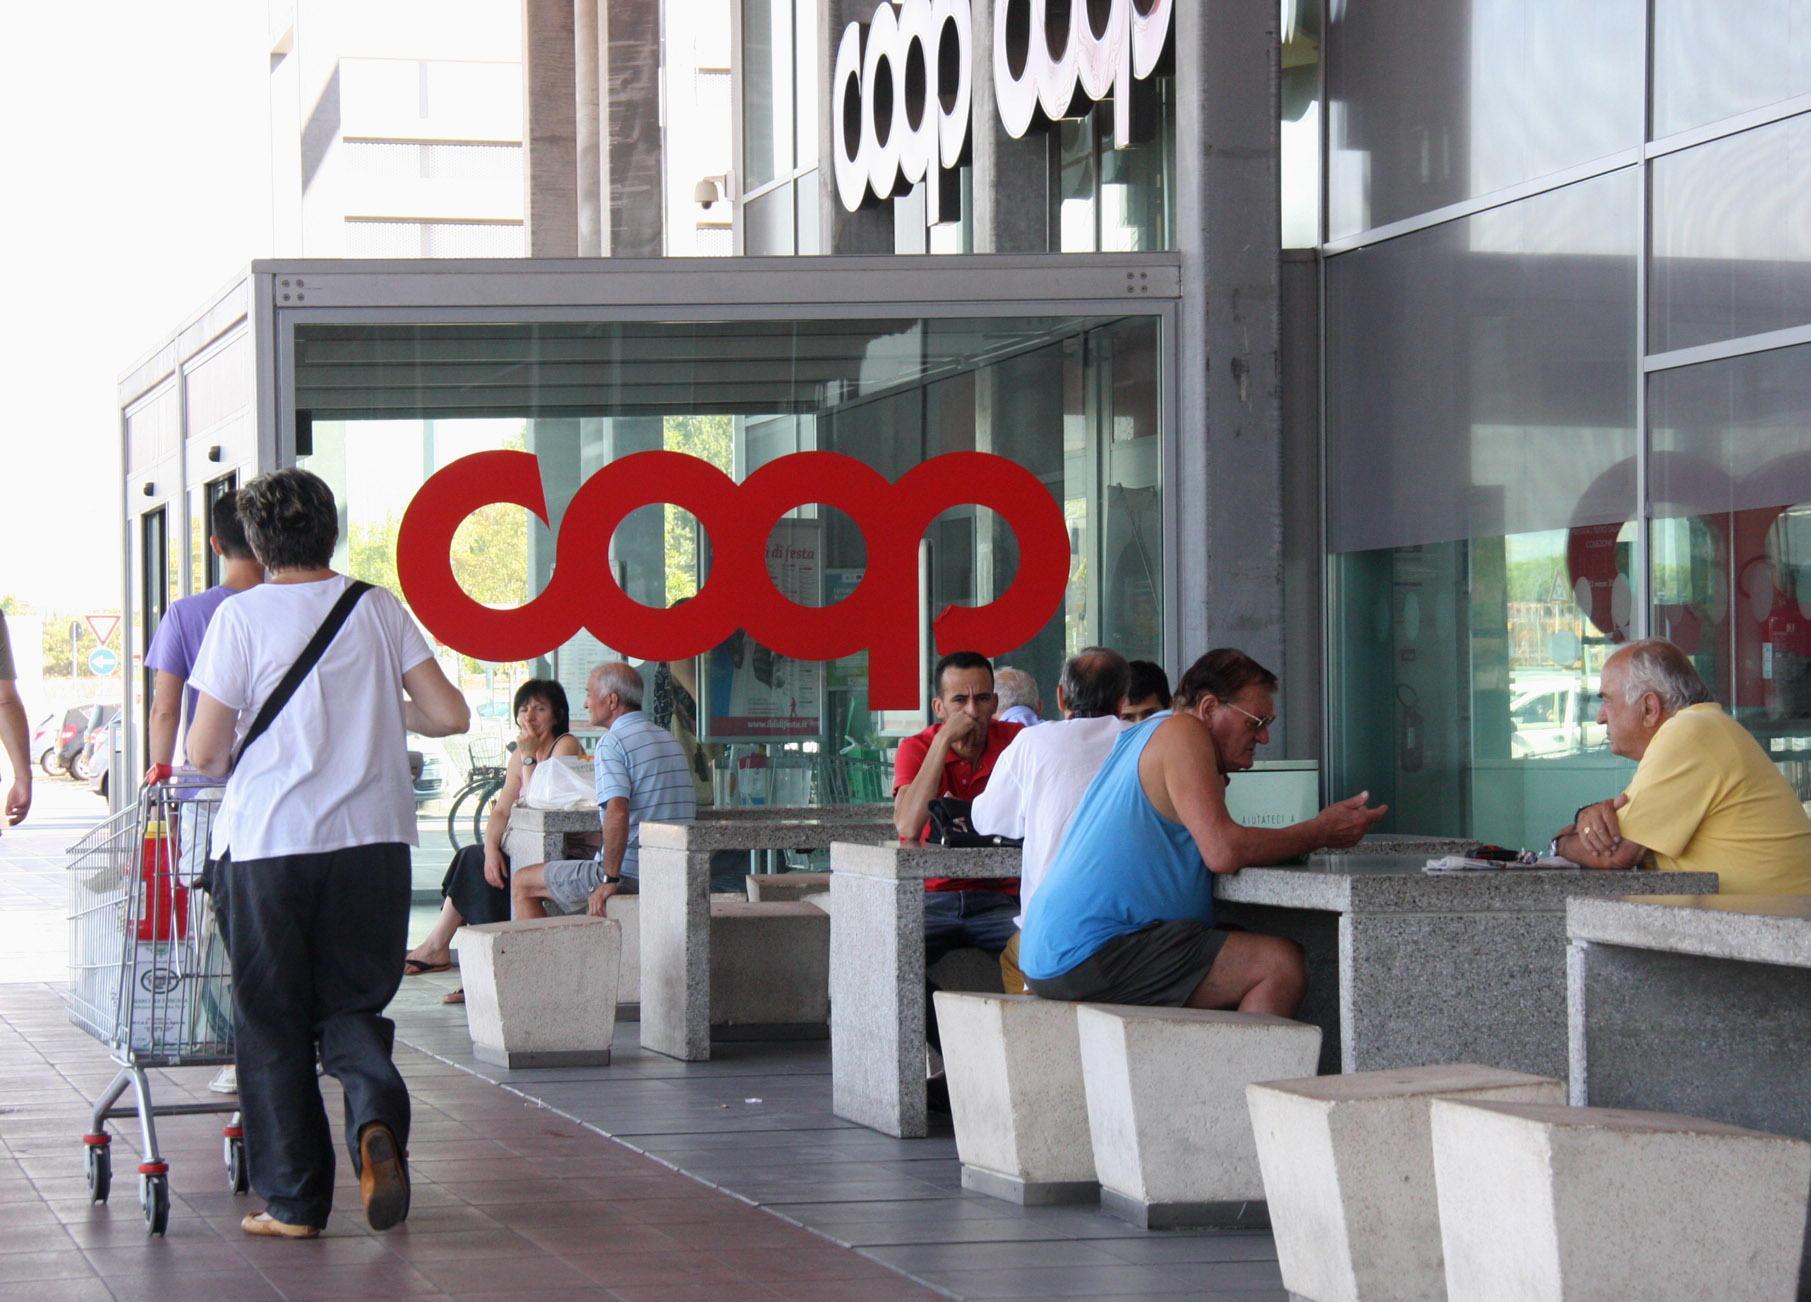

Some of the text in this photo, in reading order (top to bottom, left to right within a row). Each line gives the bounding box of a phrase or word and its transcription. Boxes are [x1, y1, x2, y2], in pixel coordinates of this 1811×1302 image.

[833, 0, 973, 227] coop
[396, 450, 1071, 711] coop
[785, 544, 815, 562] festa
[1242, 815, 1285, 825] AIUTATECI
